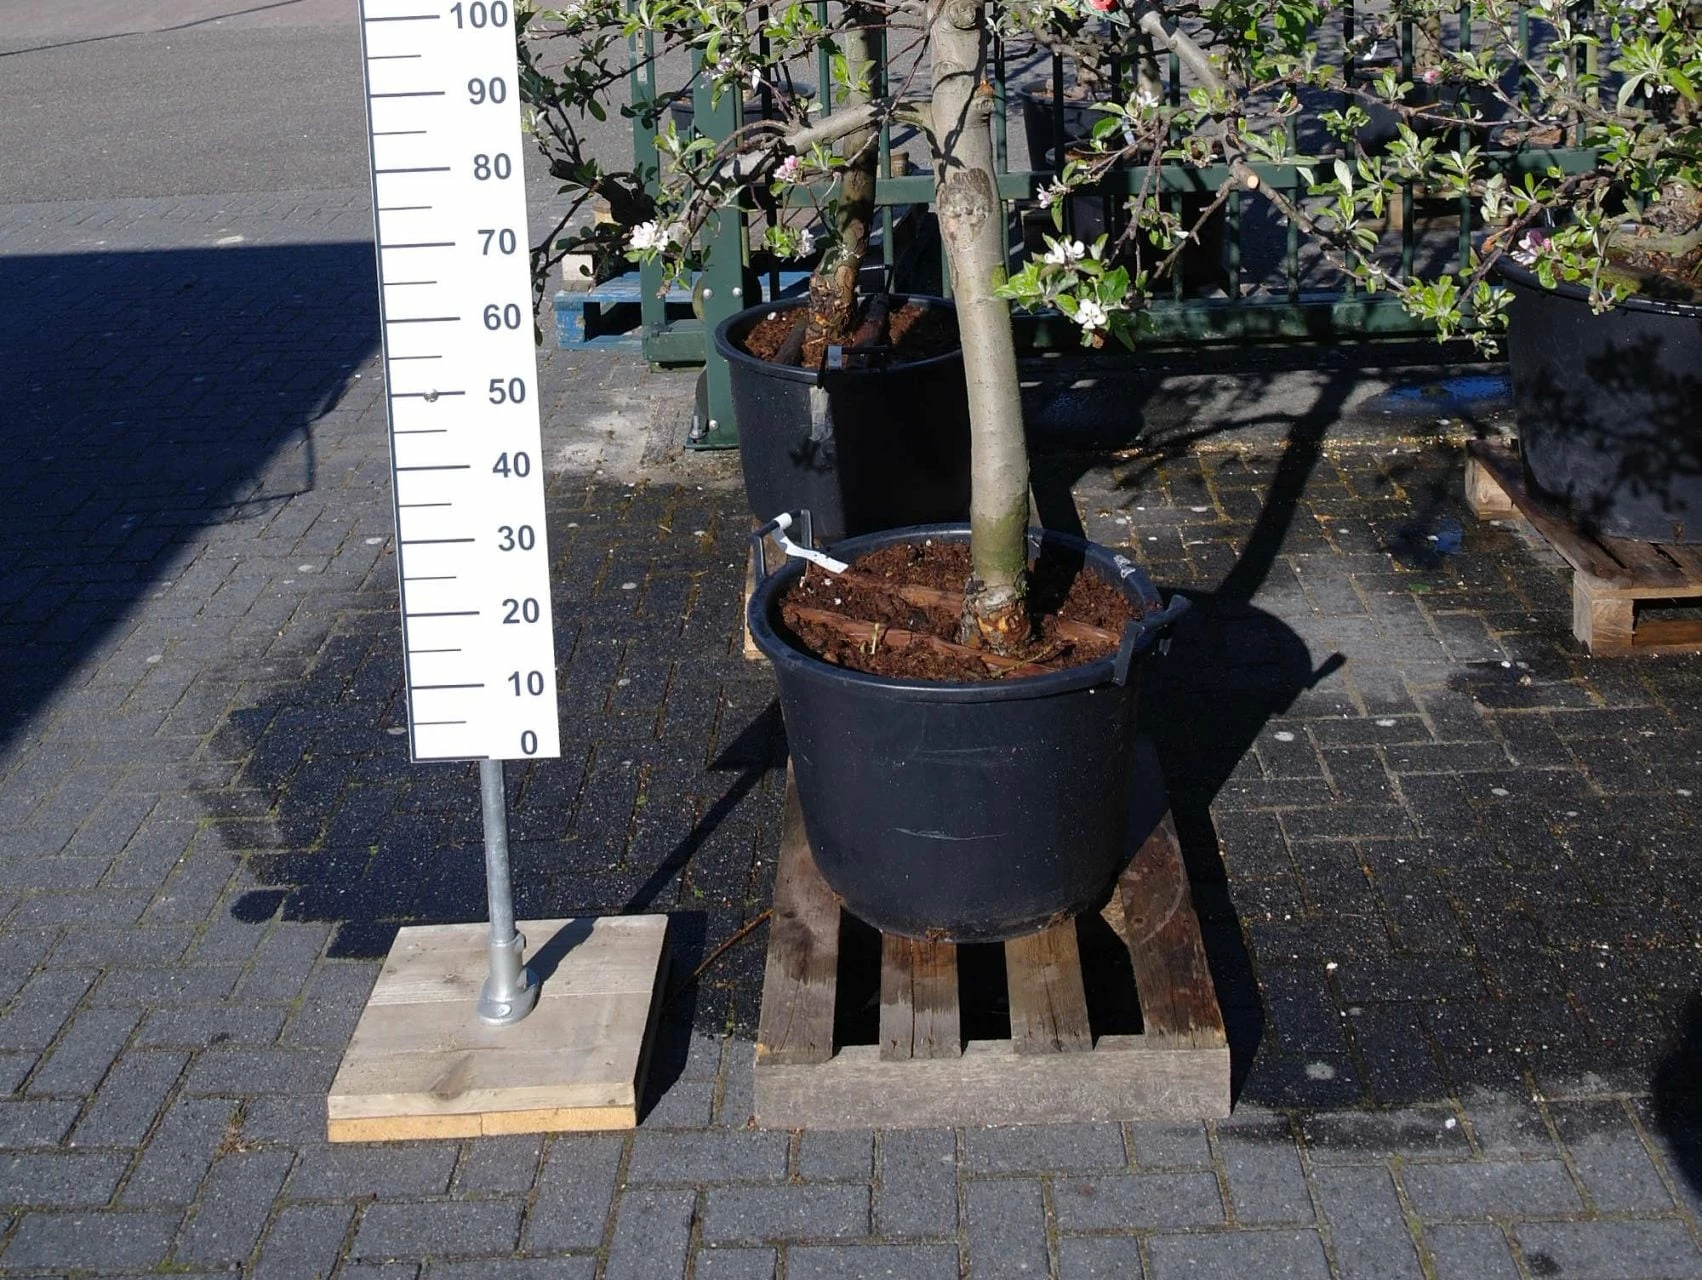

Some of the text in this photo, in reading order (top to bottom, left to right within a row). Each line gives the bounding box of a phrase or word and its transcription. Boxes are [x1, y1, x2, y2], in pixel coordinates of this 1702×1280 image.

[450, 0, 508, 29] 100
[468, 77, 506, 105] 90
[474, 153, 511, 181] 80
[478, 228, 516, 256] 70
[484, 303, 521, 330] 60
[489, 377, 525, 405] 50
[492, 452, 530, 478] 40
[498, 525, 535, 552] 30
[502, 597, 540, 624] 20
[508, 670, 544, 696] 10
[521, 730, 538, 755] 0
